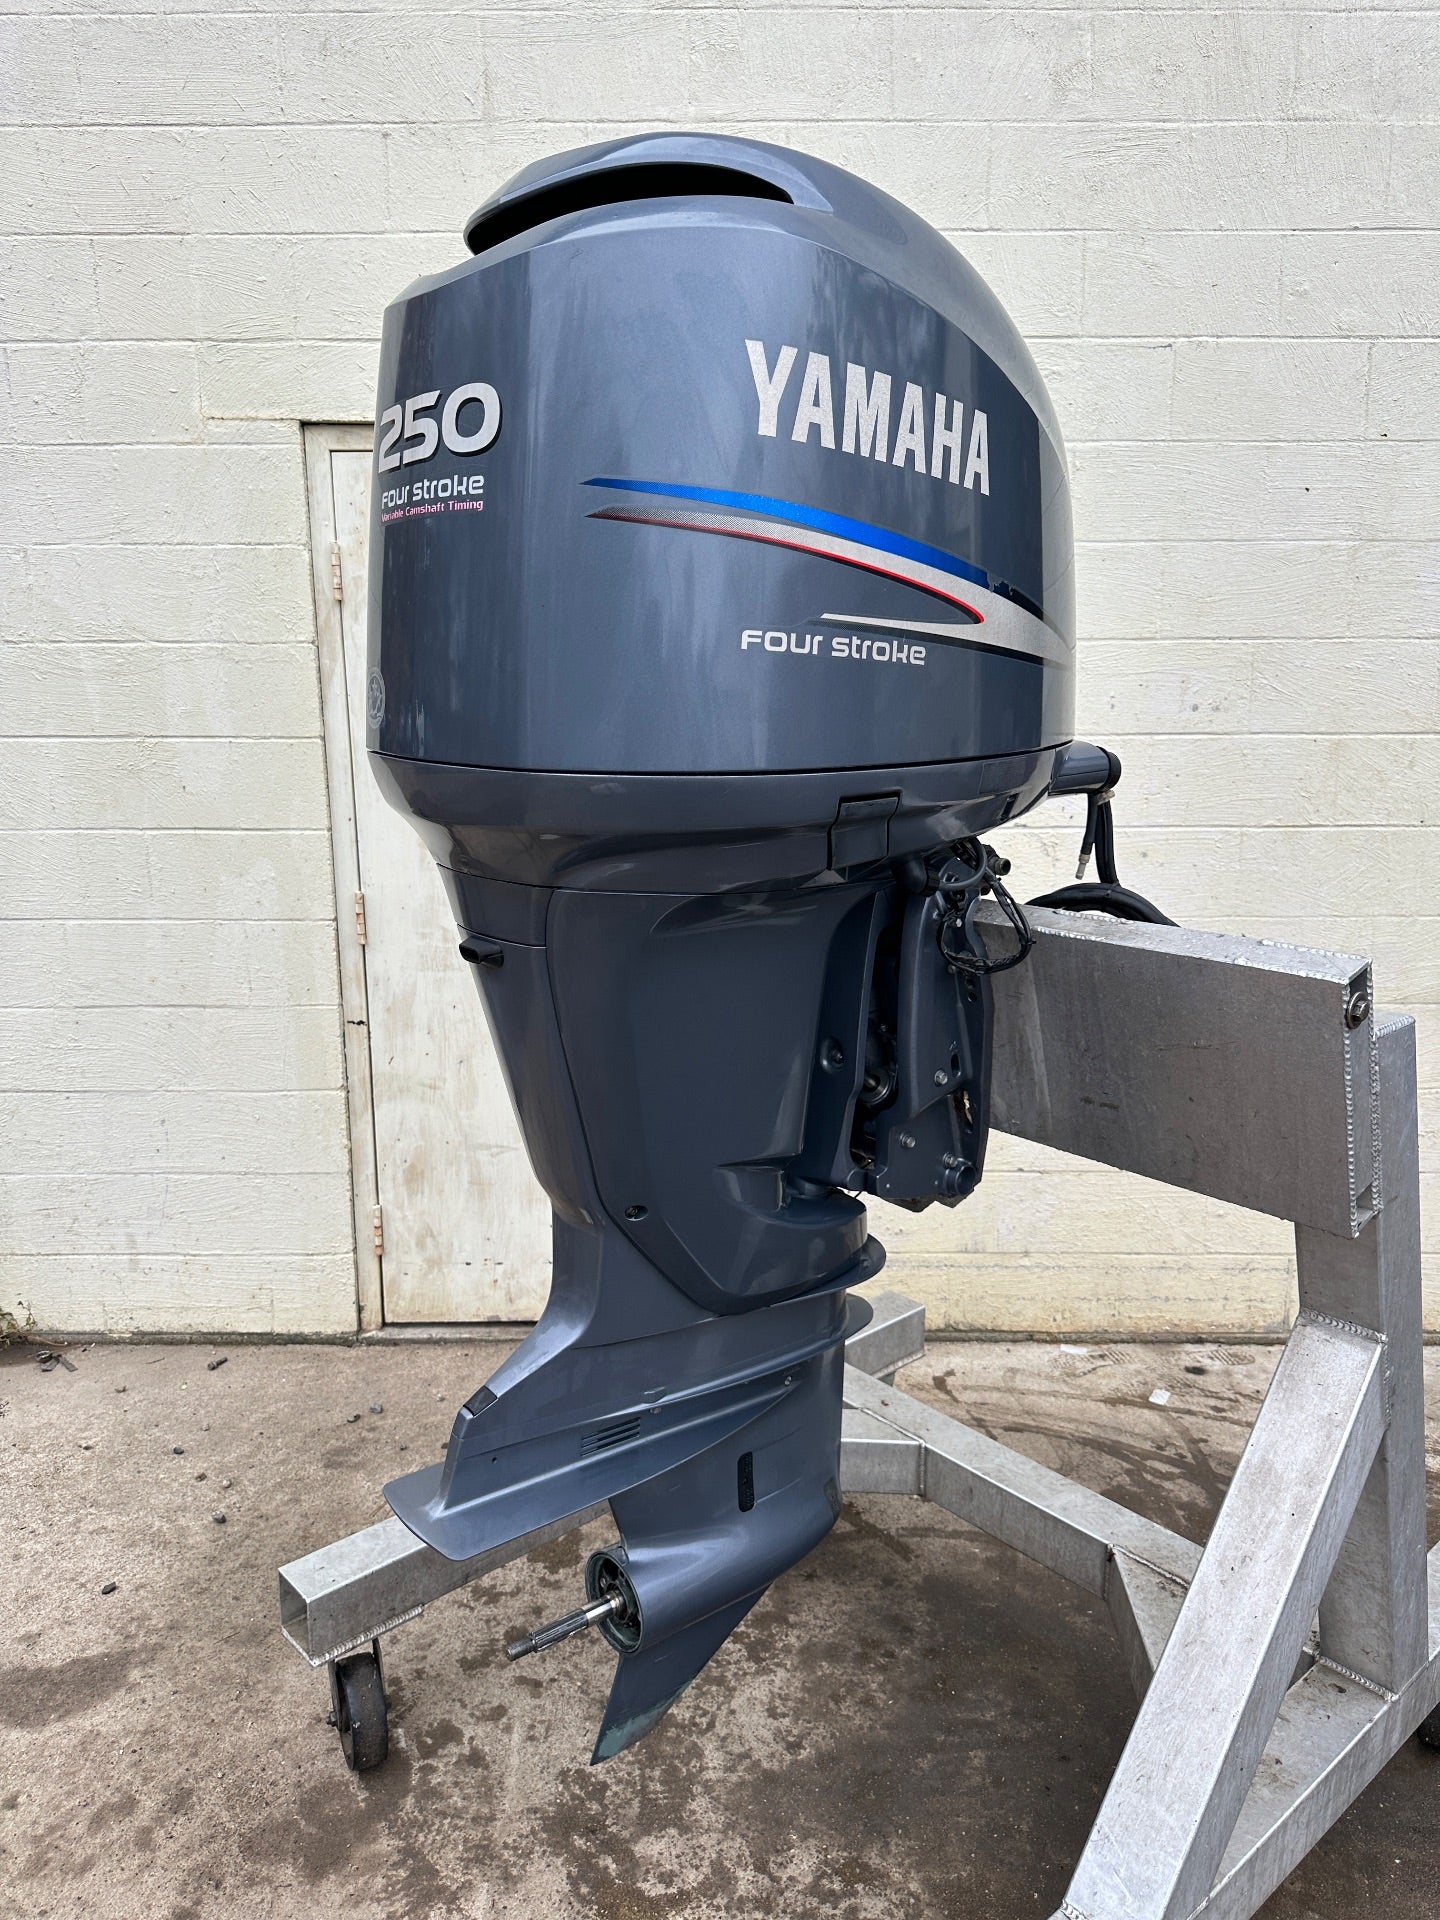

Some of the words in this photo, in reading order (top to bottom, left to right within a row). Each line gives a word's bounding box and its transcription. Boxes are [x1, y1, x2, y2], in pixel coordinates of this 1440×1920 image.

[378, 382, 502, 474] 250
[745, 339, 990, 496] YAMAHA
[405, 502, 445, 516] Camshaft
[449, 499, 484, 511] Timing
